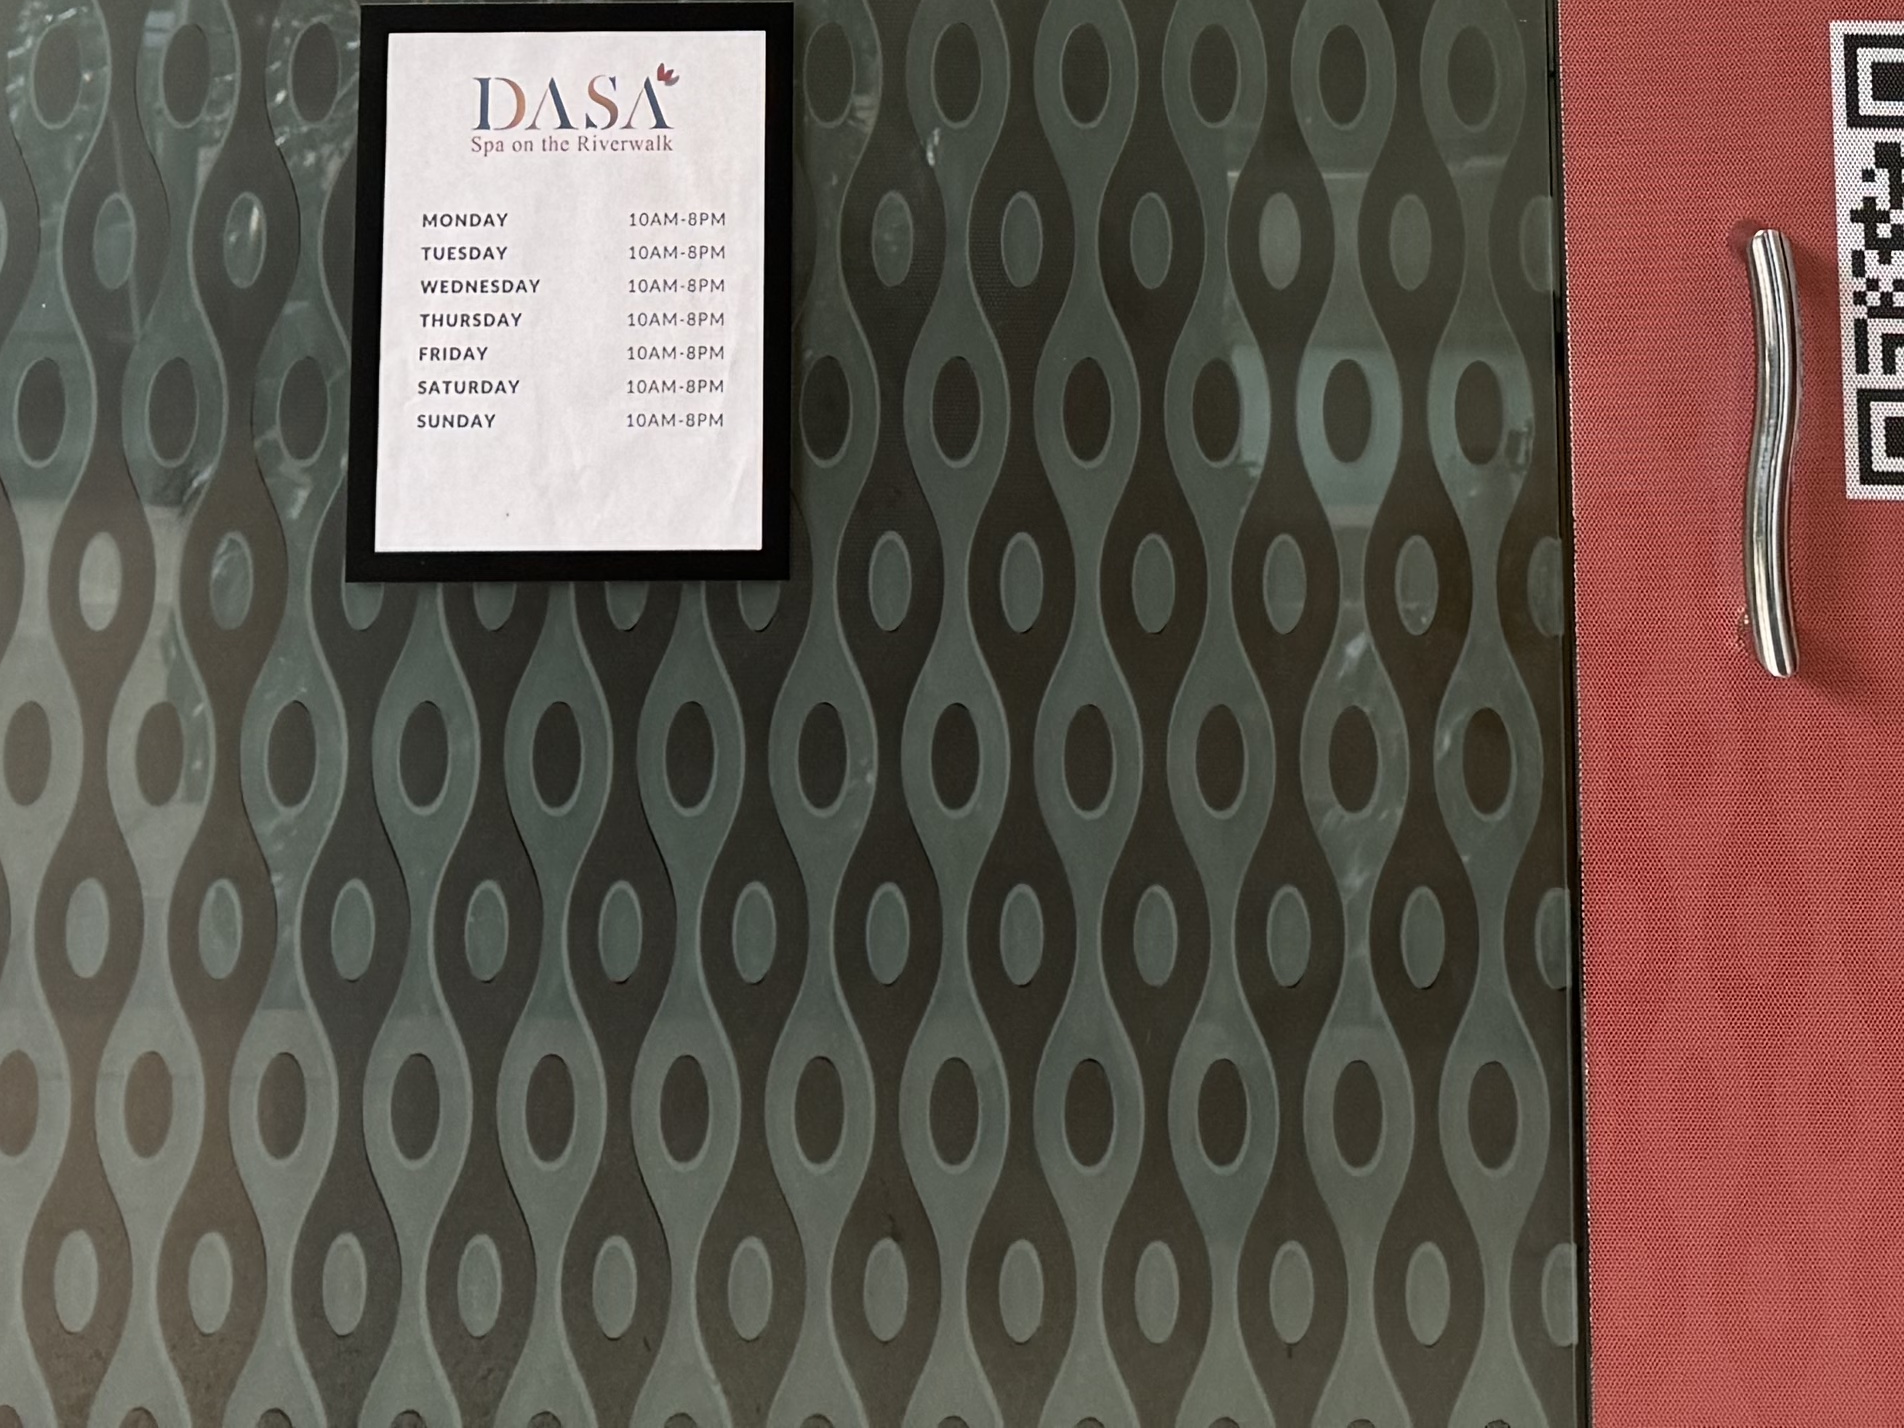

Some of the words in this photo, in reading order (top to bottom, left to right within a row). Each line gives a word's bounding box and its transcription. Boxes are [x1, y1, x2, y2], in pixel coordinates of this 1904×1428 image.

[471, 74, 674, 131] DASA
[471, 135, 505, 156] Spa
[511, 138, 535, 153] on
[541, 136, 570, 153] the
[576, 135, 673, 153] Riverwalk
[422, 213, 508, 228] MONDAY
[628, 211, 726, 227] 10AM-8PM
[421, 246, 508, 261] TUESDAY
[628, 245, 726, 260] 10AM-8PM
[421, 279, 541, 294] WEDNESDAY
[627, 278, 725, 293] 10AM-8PM
[420, 313, 522, 327] THURSDAY
[627, 312, 725, 327] 10AM-8PM
[419, 347, 489, 361] FRIDAY
[626, 345, 725, 360] 10AM-8PM
[417, 380, 521, 395] SATURDAY
[626, 379, 724, 394] 10AM-8PM
[417, 414, 496, 429] SUNDAY
[625, 413, 724, 428] 10AM-8PM
